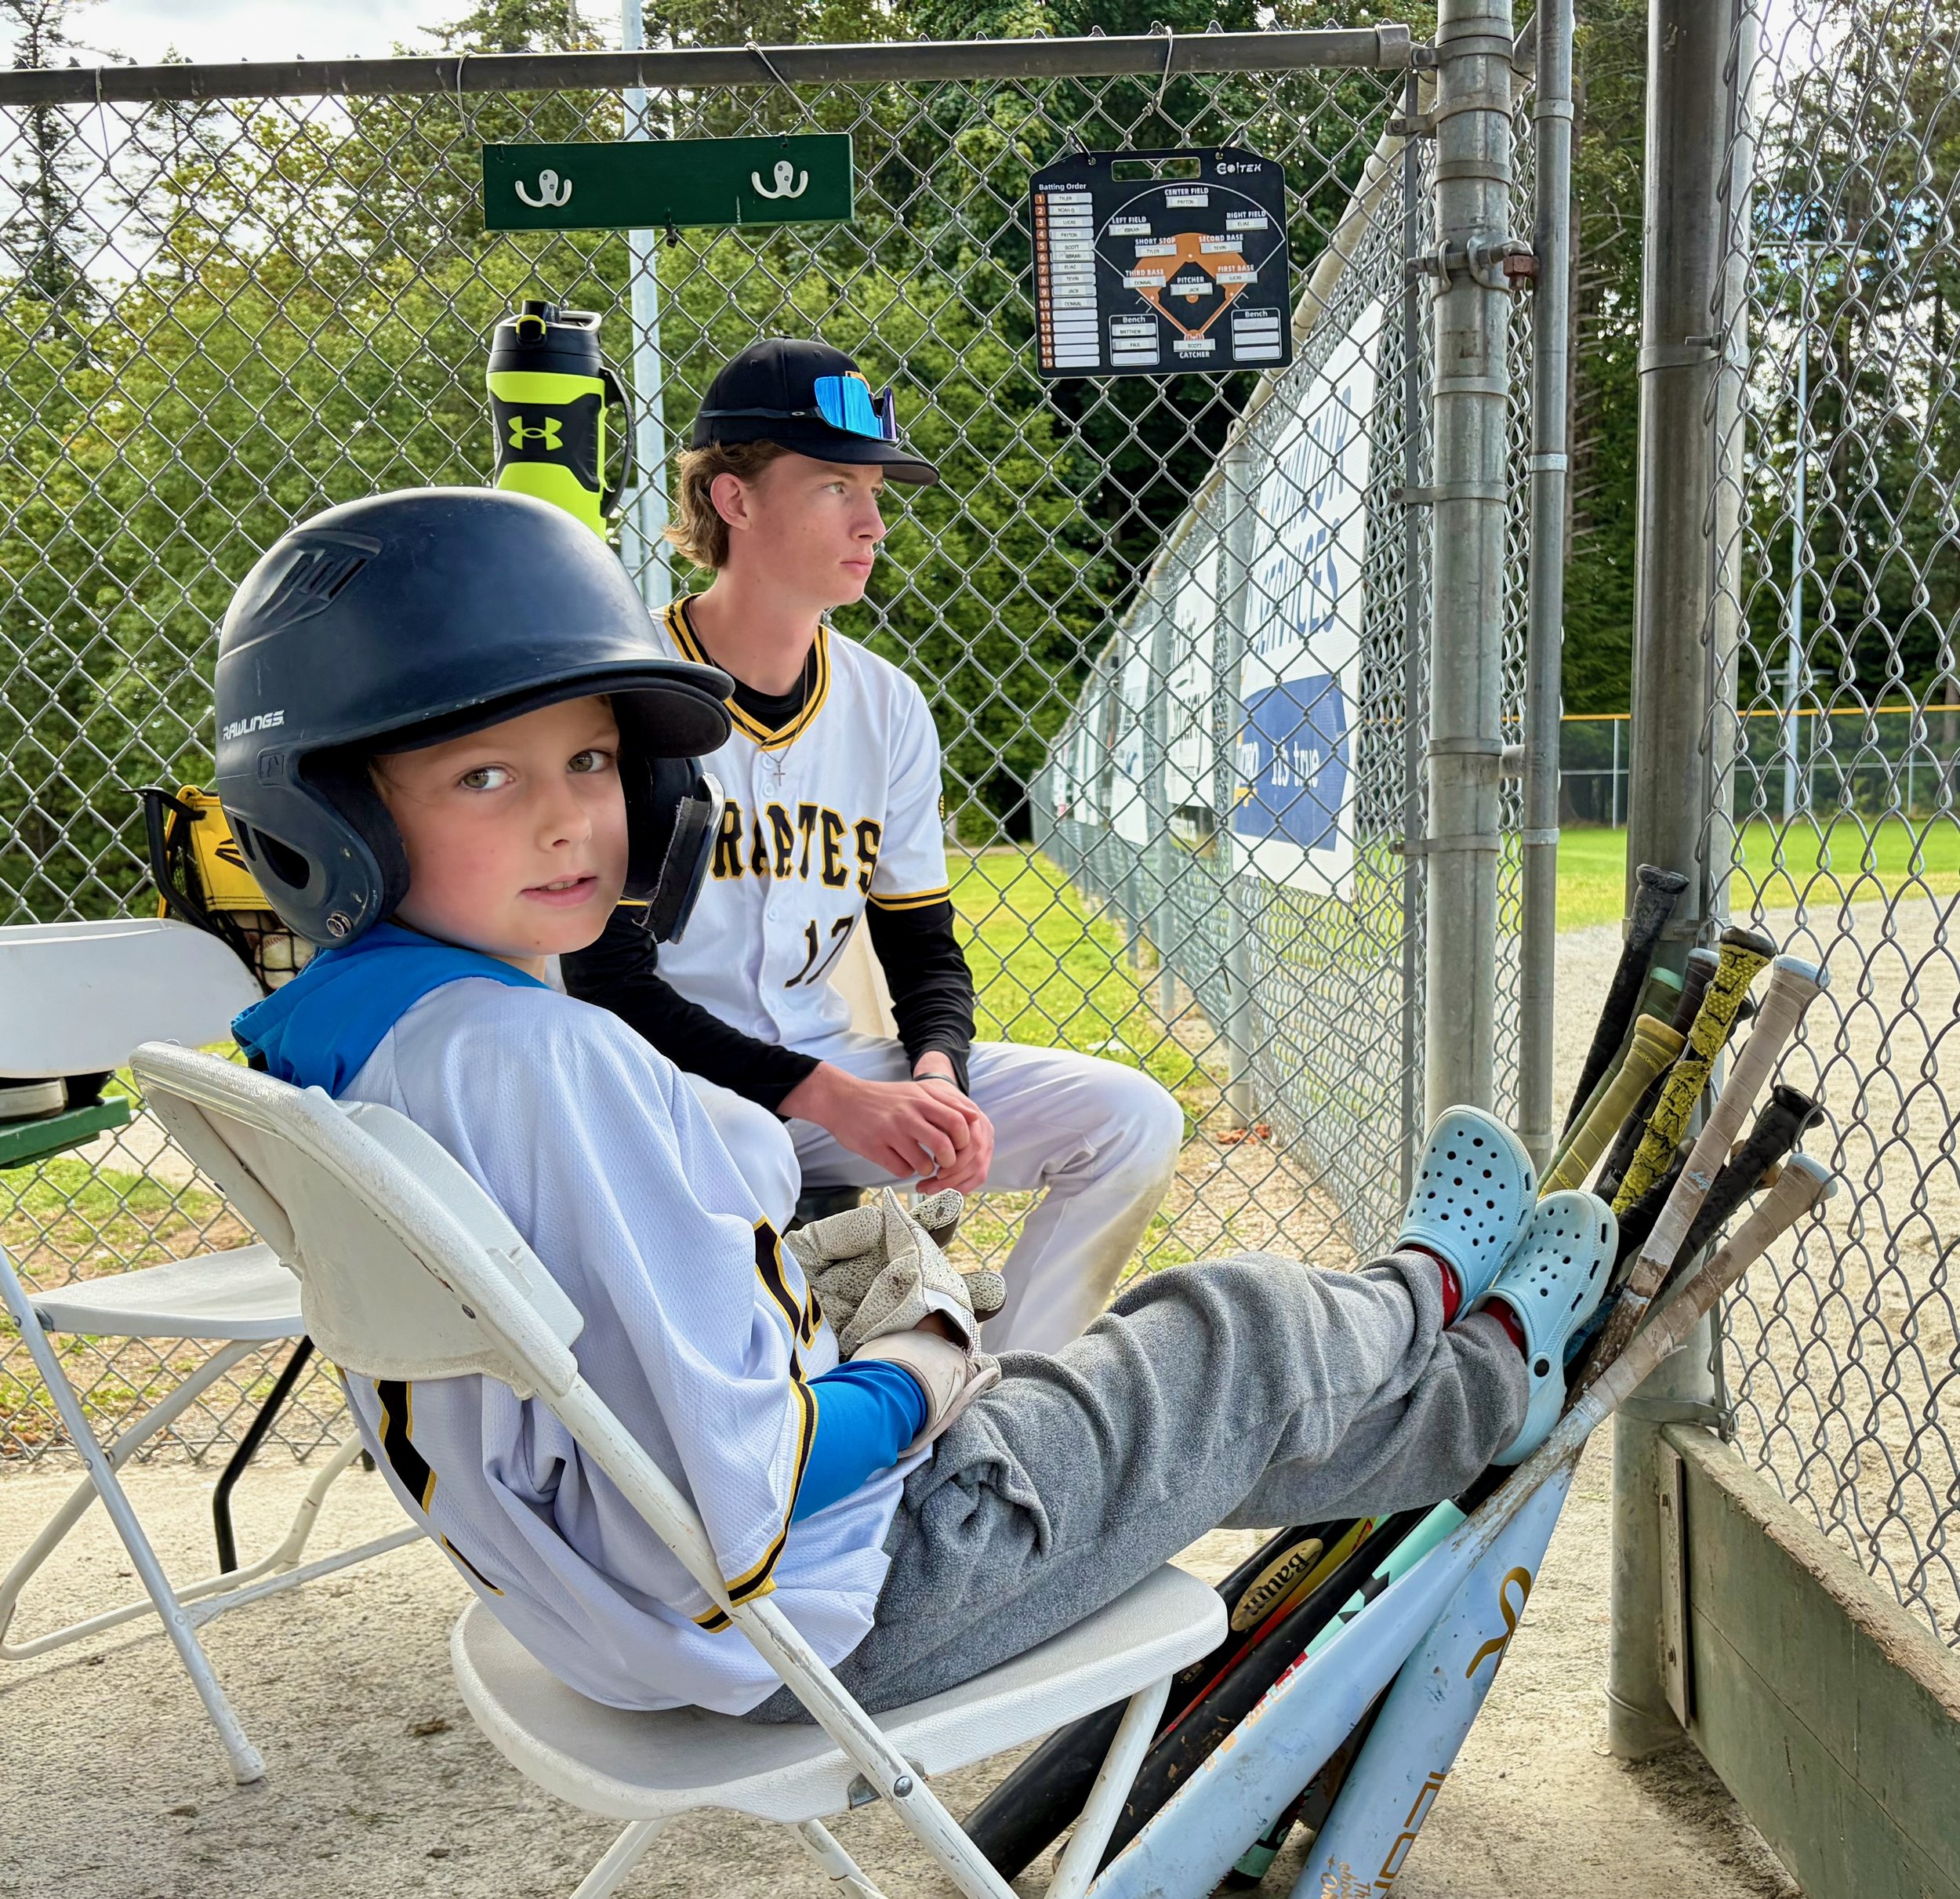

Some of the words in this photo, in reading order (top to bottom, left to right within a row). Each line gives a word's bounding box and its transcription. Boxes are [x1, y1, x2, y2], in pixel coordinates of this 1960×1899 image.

[223, 710, 285, 741] RAWLINGS
[1294, 740, 1320, 788] true
[710, 797, 883, 899] RATES
[784, 914, 855, 989] 17
[1243, 1552, 1310, 1616] Baum
